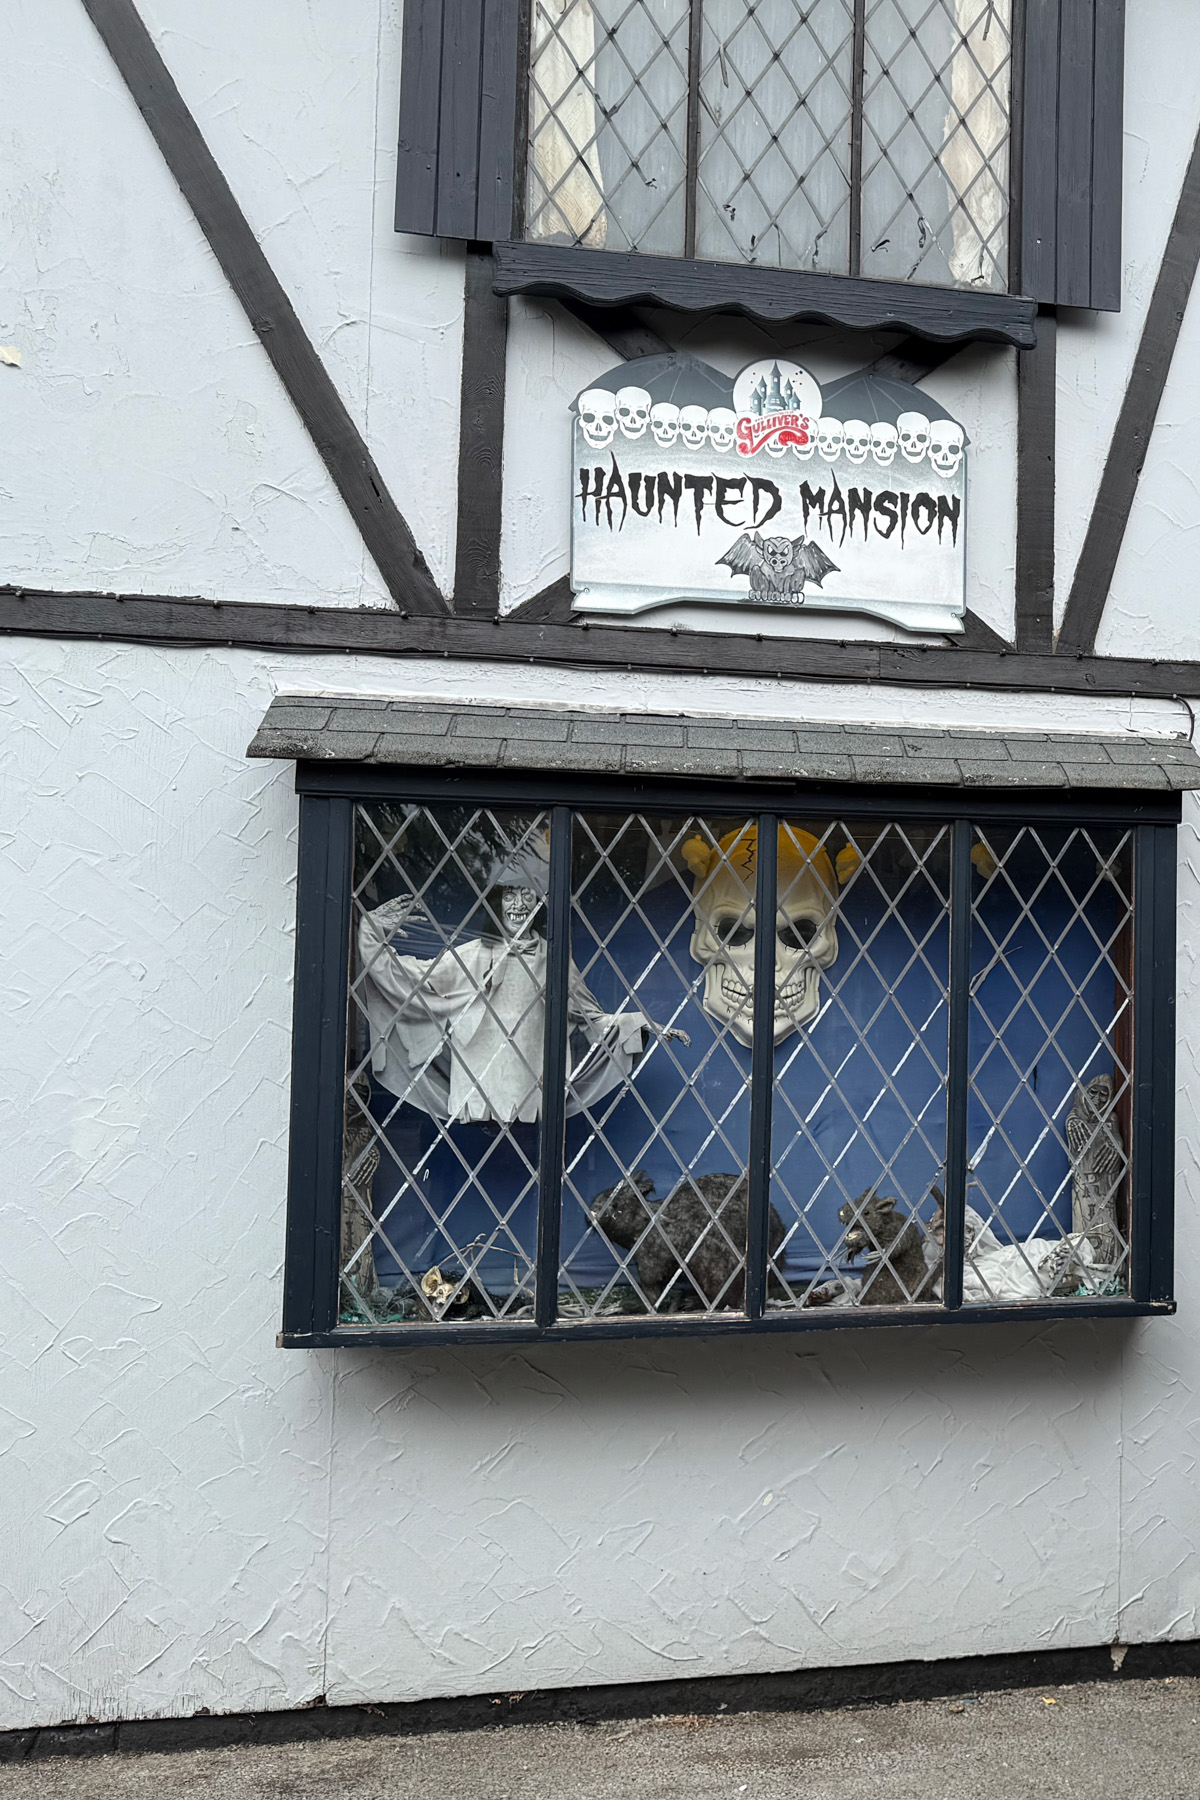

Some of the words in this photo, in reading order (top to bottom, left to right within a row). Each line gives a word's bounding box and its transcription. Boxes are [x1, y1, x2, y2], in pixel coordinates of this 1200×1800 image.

[736, 413, 810, 450] GULLIVER'S
[575, 450, 782, 536] HAUNTED
[799, 468, 961, 549] MANSION
